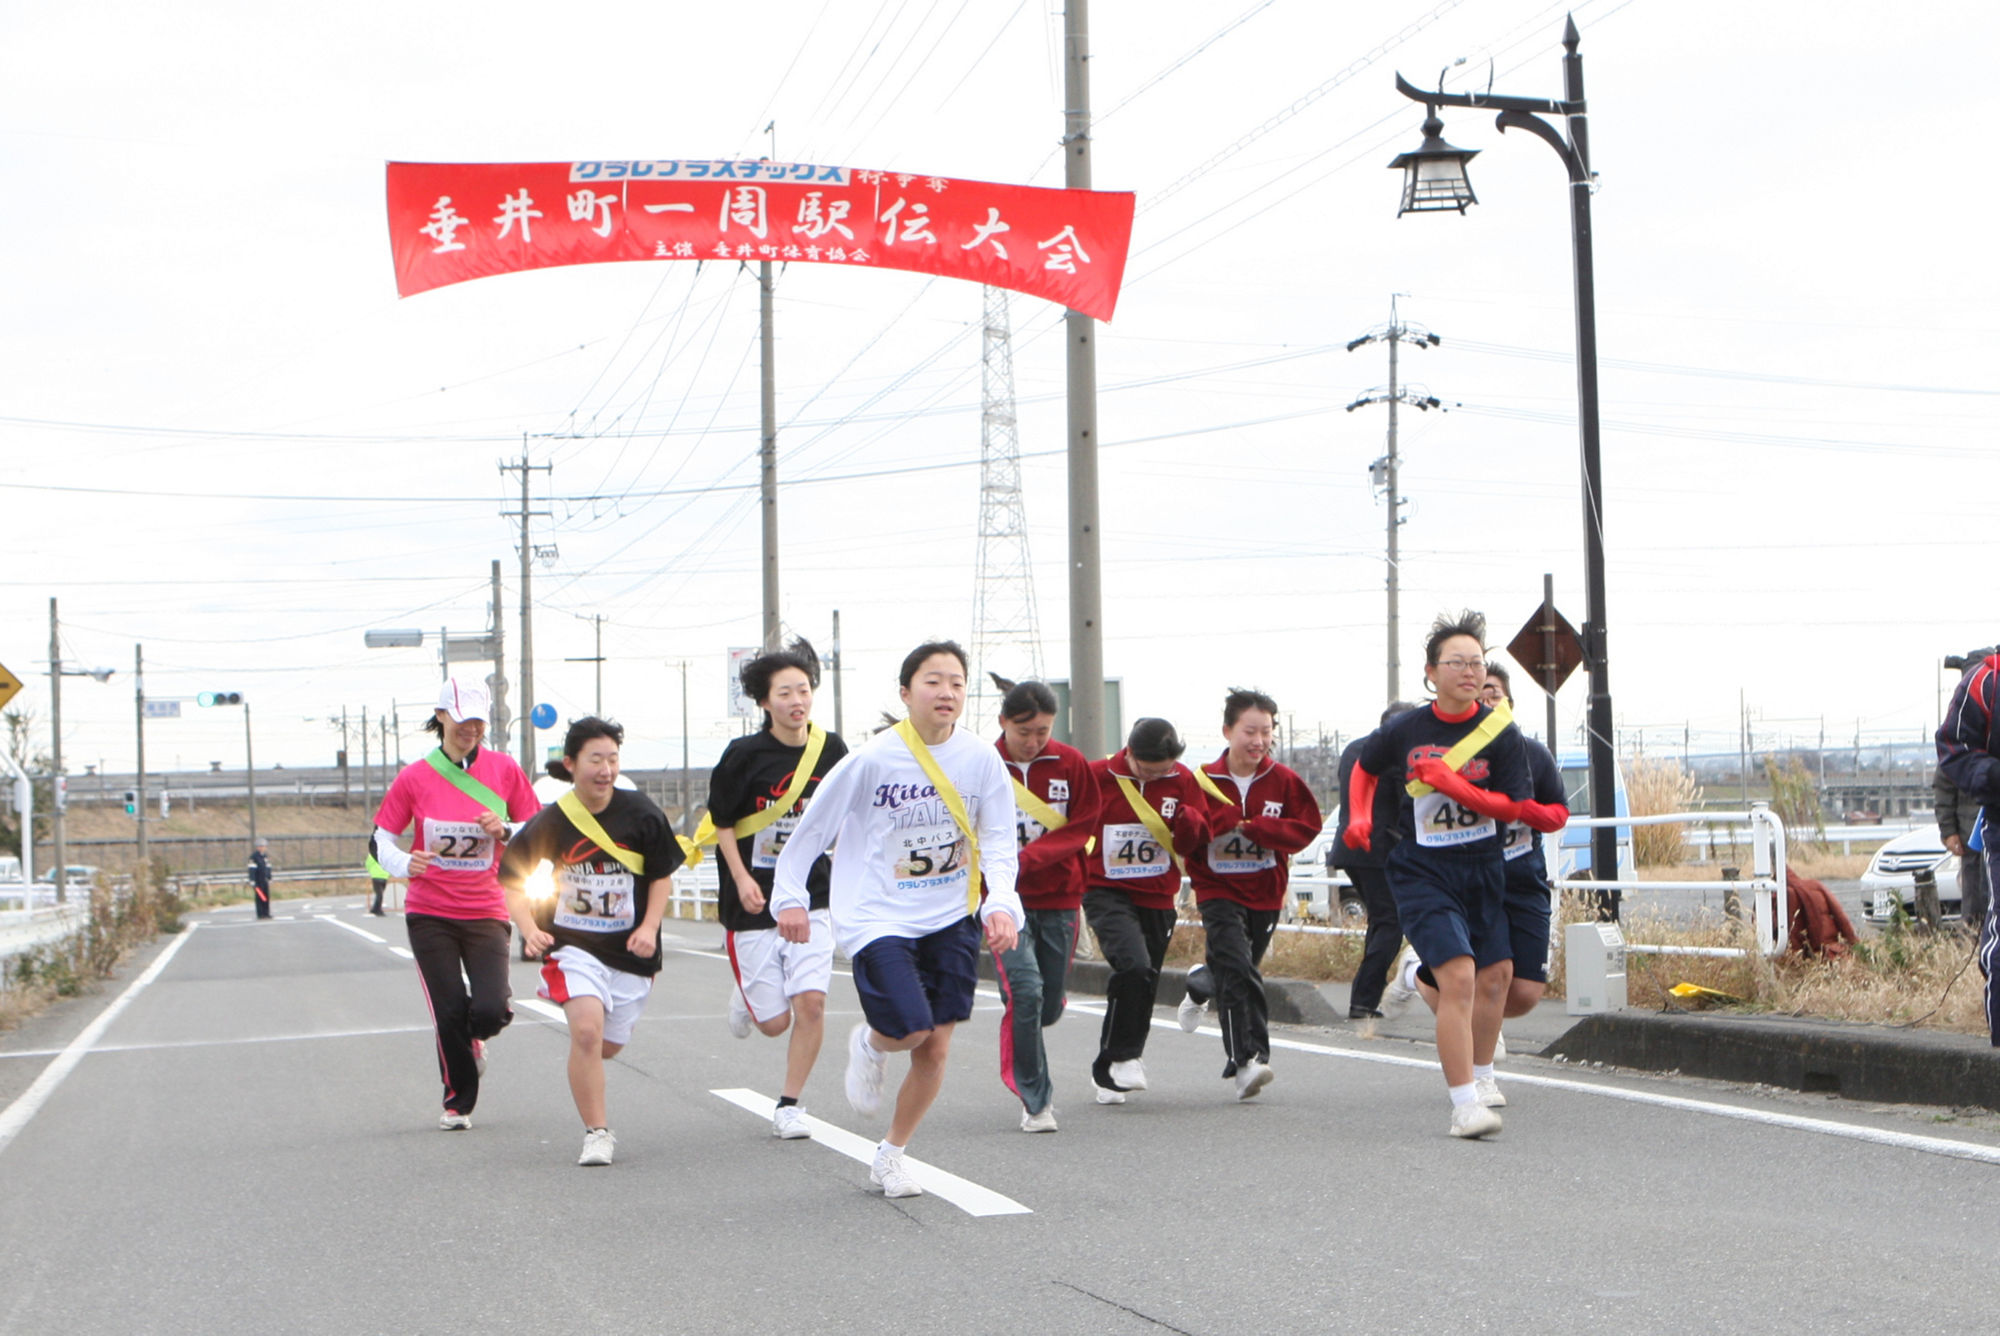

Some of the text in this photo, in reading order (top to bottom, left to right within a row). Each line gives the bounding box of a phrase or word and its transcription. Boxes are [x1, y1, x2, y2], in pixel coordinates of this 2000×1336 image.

[419, 185, 1091, 275] 垂井町一周駅伝大会
[654, 241, 872, 263] 主催 垂井町体育協会
[1433, 802, 1478, 830] 48
[440, 835, 478, 858] 22
[910, 841, 959, 877] 52
[1118, 839, 1155, 864] 46
[1224, 836, 1265, 860] 44
[574, 888, 616, 918] 51
